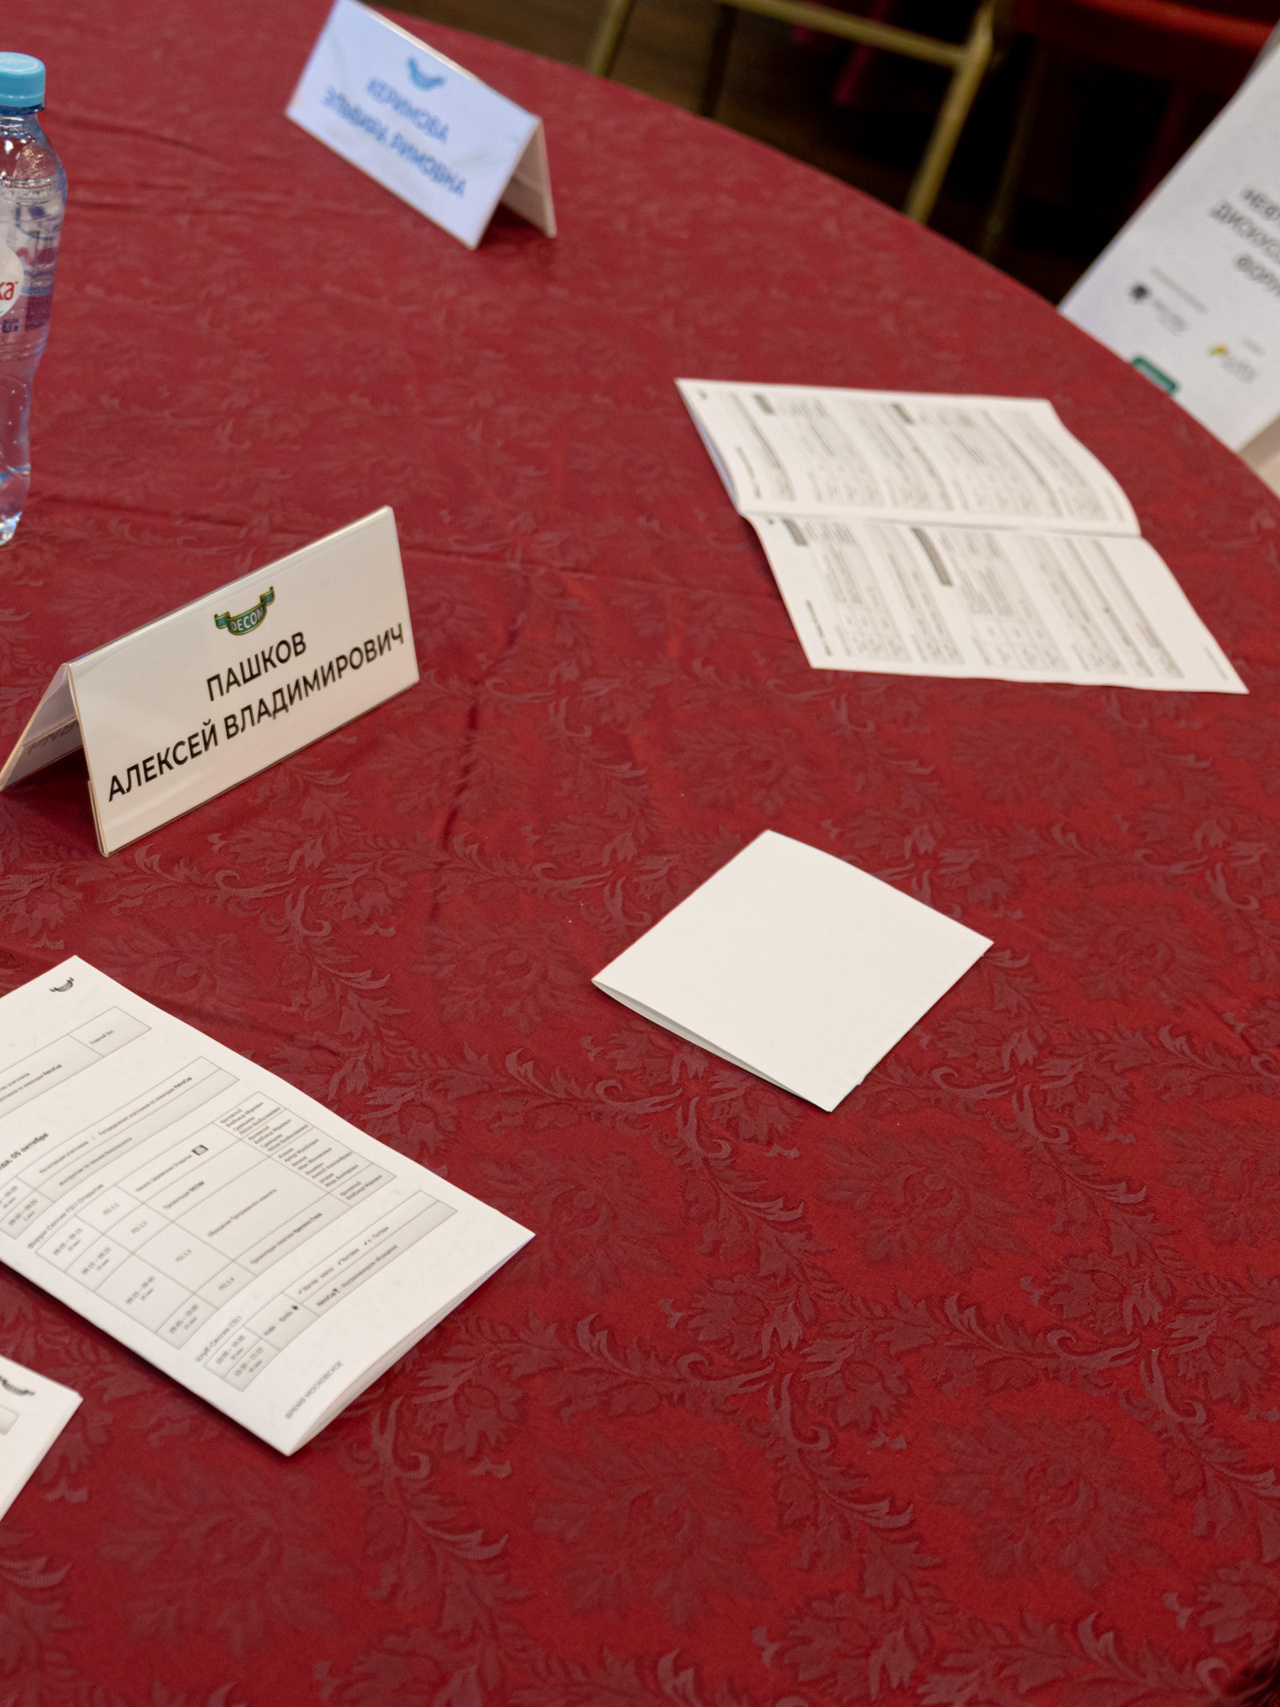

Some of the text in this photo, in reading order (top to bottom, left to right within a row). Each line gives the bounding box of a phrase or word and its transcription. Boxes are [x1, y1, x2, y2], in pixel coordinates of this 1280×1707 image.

[230, 606, 265, 631] DECOM
[207, 632, 307, 701] ПАШКОВ
[109, 623, 404, 802] АЛЕКСЕЙ ВЛАДИМИРОВИЧ
[21, 1133, 49, 1152] октября
